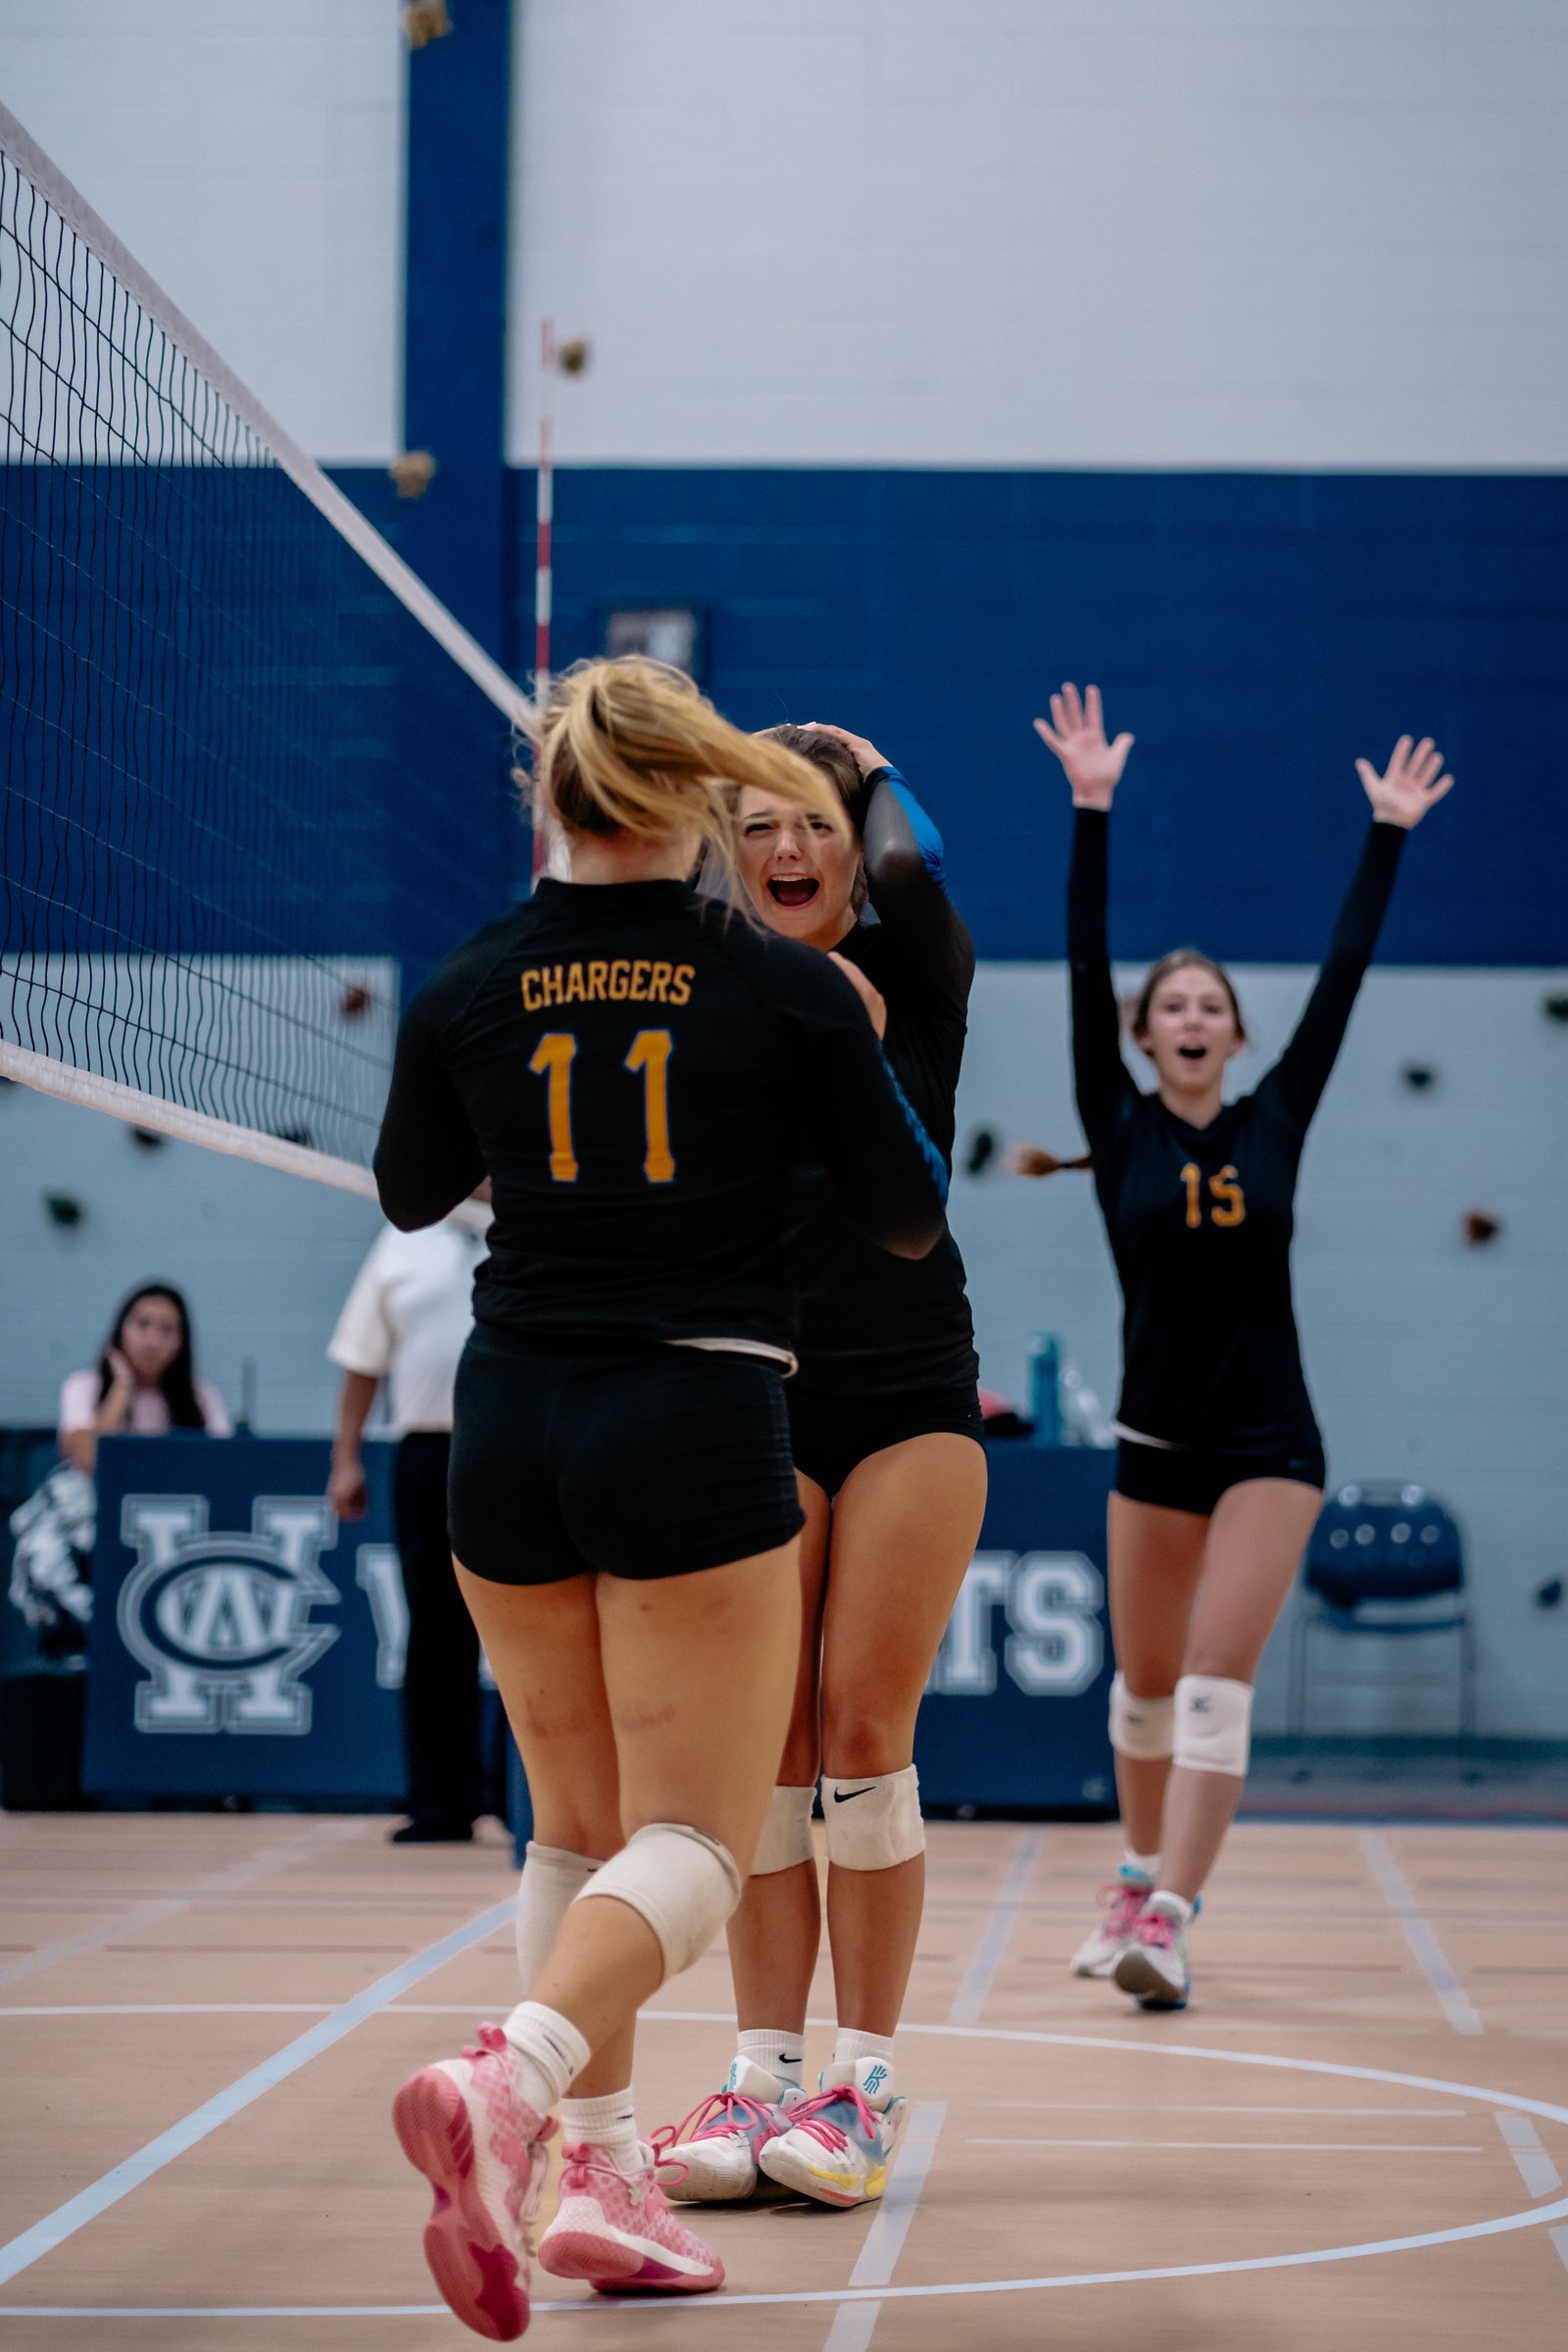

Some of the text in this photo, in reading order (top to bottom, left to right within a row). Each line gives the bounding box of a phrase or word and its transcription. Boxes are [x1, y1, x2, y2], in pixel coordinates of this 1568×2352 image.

[520, 959, 696, 1011] CHARGERS
[527, 1029, 676, 1184] 11
[1180, 1162, 1246, 1228] 15
